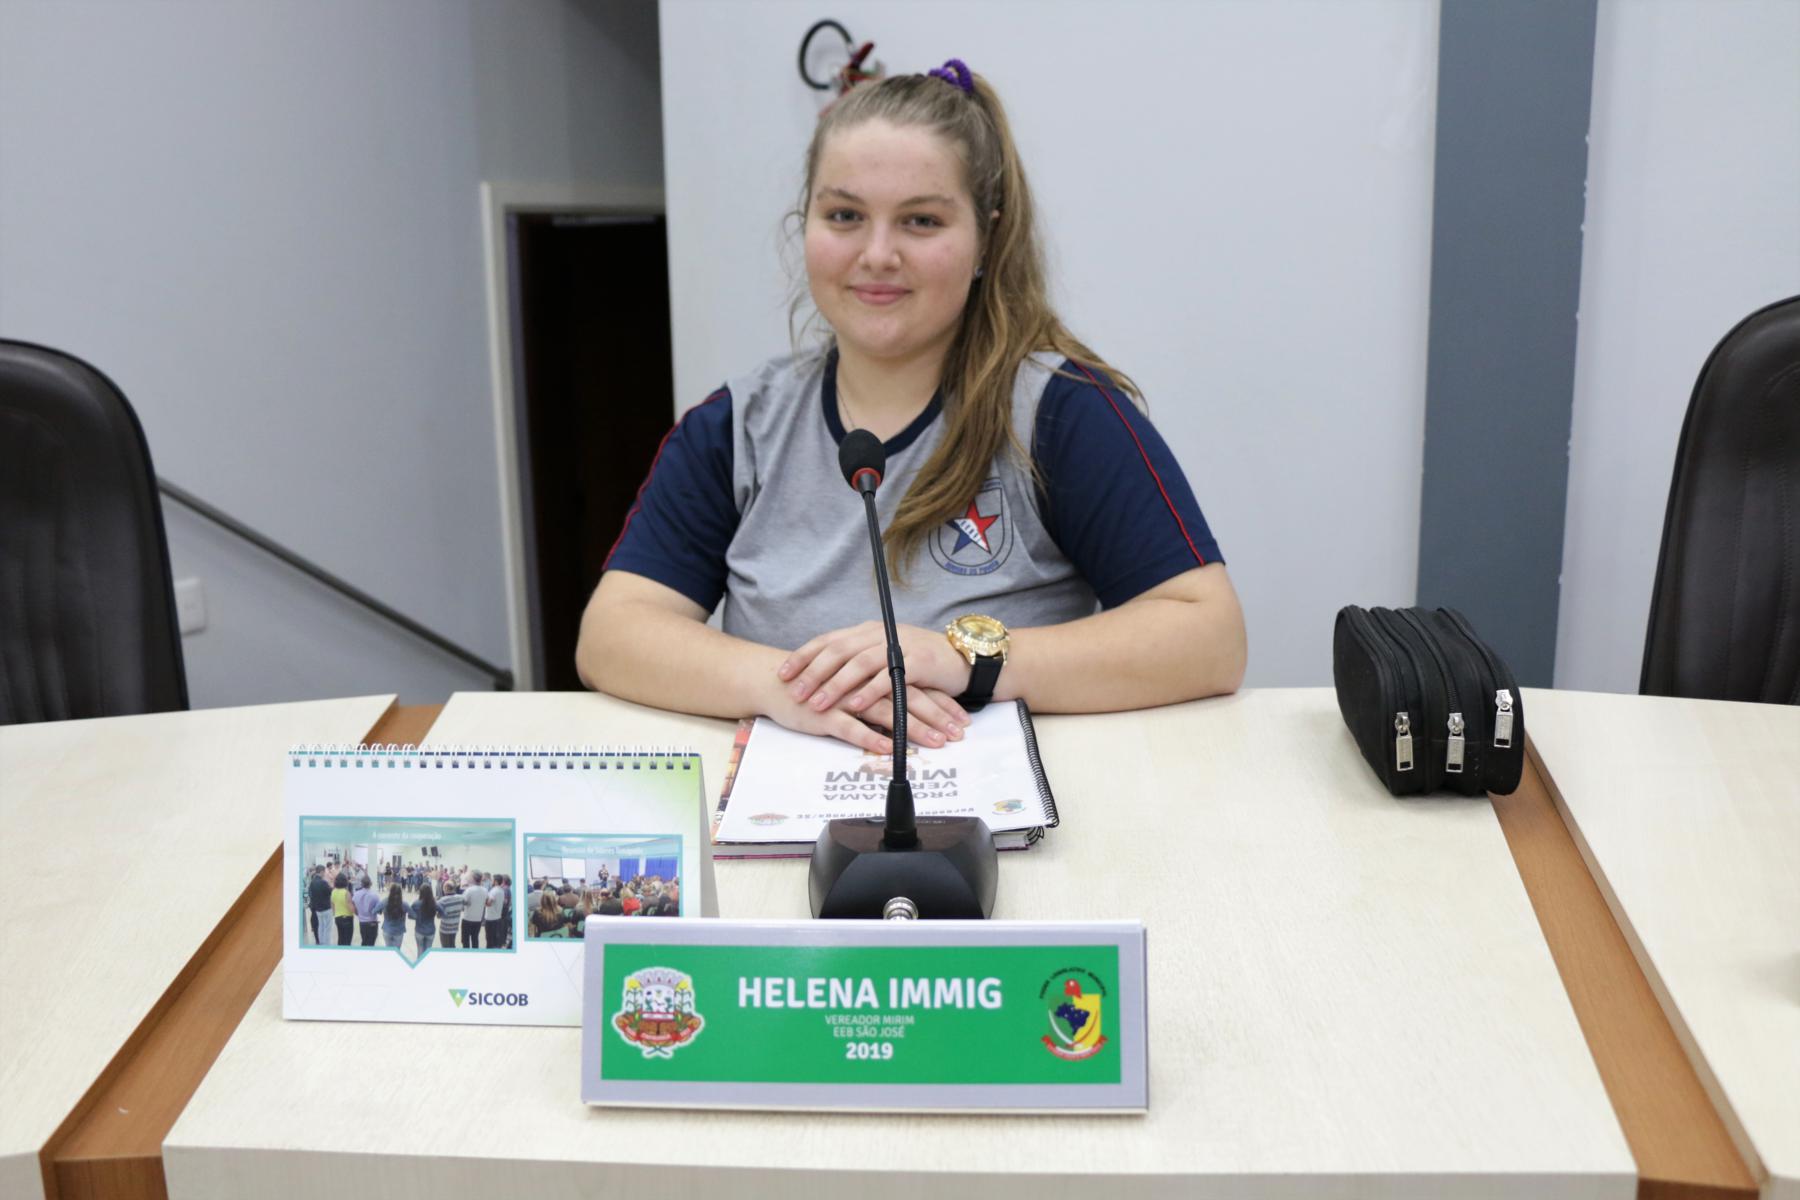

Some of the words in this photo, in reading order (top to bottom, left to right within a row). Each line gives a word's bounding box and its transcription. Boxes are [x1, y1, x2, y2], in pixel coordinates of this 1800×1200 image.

[824, 782, 958, 791] VERADOR
[823, 791, 958, 801] PRORAMA
[738, 976, 880, 1009] HELENA
[889, 976, 1003, 1009] IMMIG
[468, 992, 529, 1007] SICOOB
[824, 1014, 881, 1025] VEREADOR
[882, 1014, 915, 1025] MIRIM
[833, 1026, 855, 1038] EEB
[856, 1025, 878, 1038] SÃO
[879, 1025, 906, 1038] JOSÉ
[845, 1041, 894, 1060] 2019
